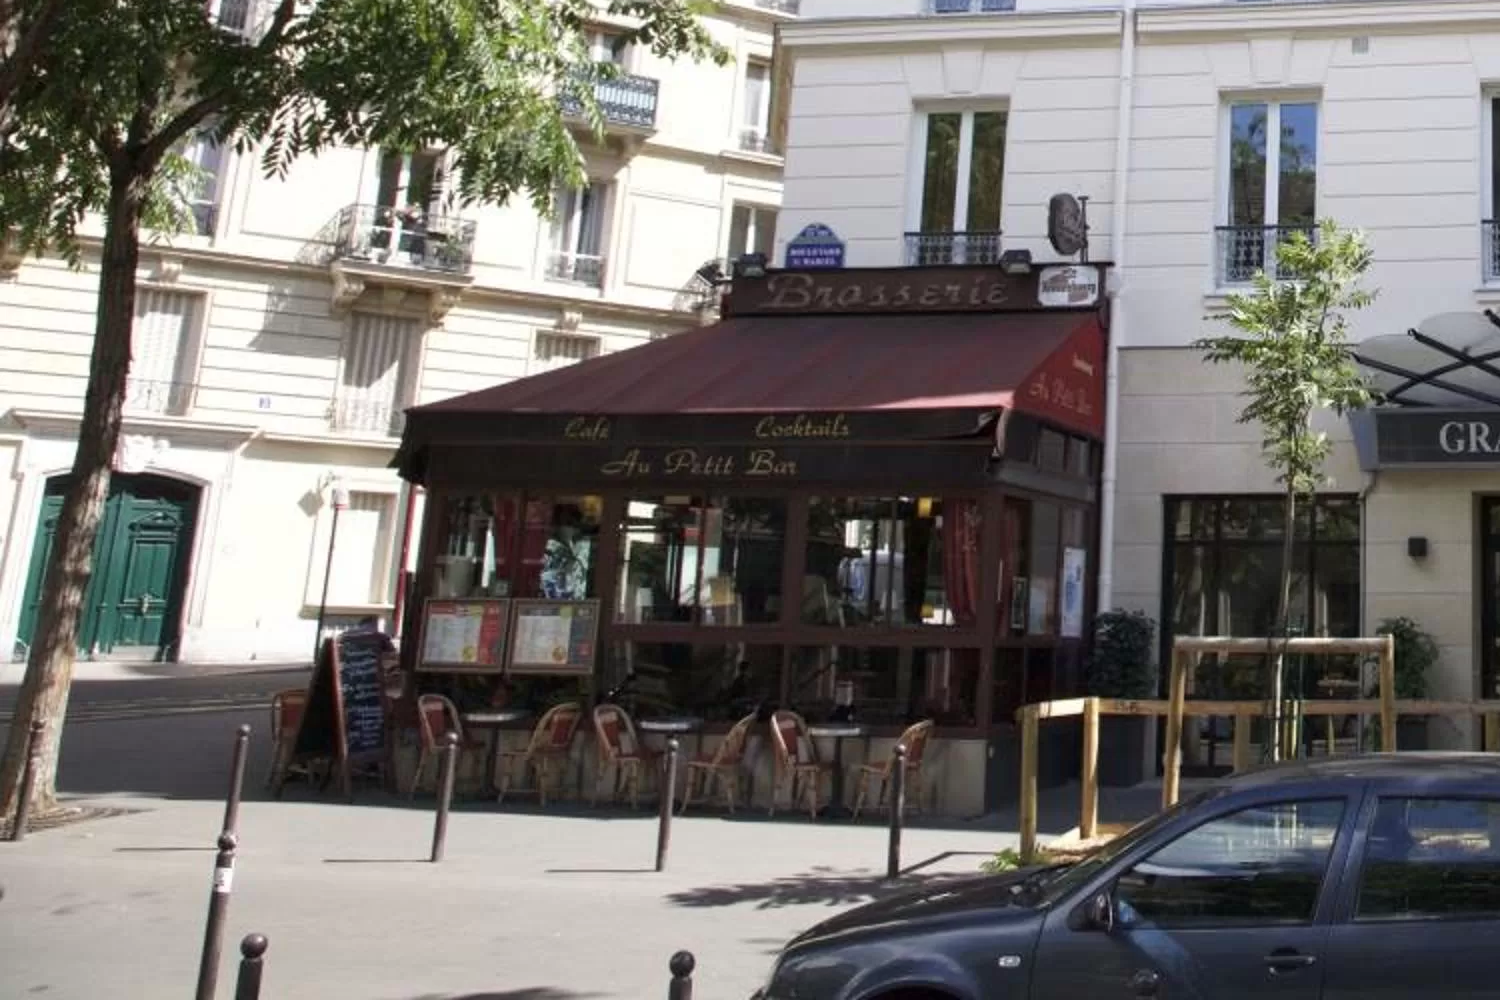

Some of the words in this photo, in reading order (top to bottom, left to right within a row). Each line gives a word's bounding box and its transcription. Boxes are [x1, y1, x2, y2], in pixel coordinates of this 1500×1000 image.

[758, 273, 1009, 308] Brasserie
[755, 412, 850, 437] Cocktails
[601, 448, 650, 477] Au
[663, 449, 735, 476] Petit
[746, 448, 798, 476] Bar
